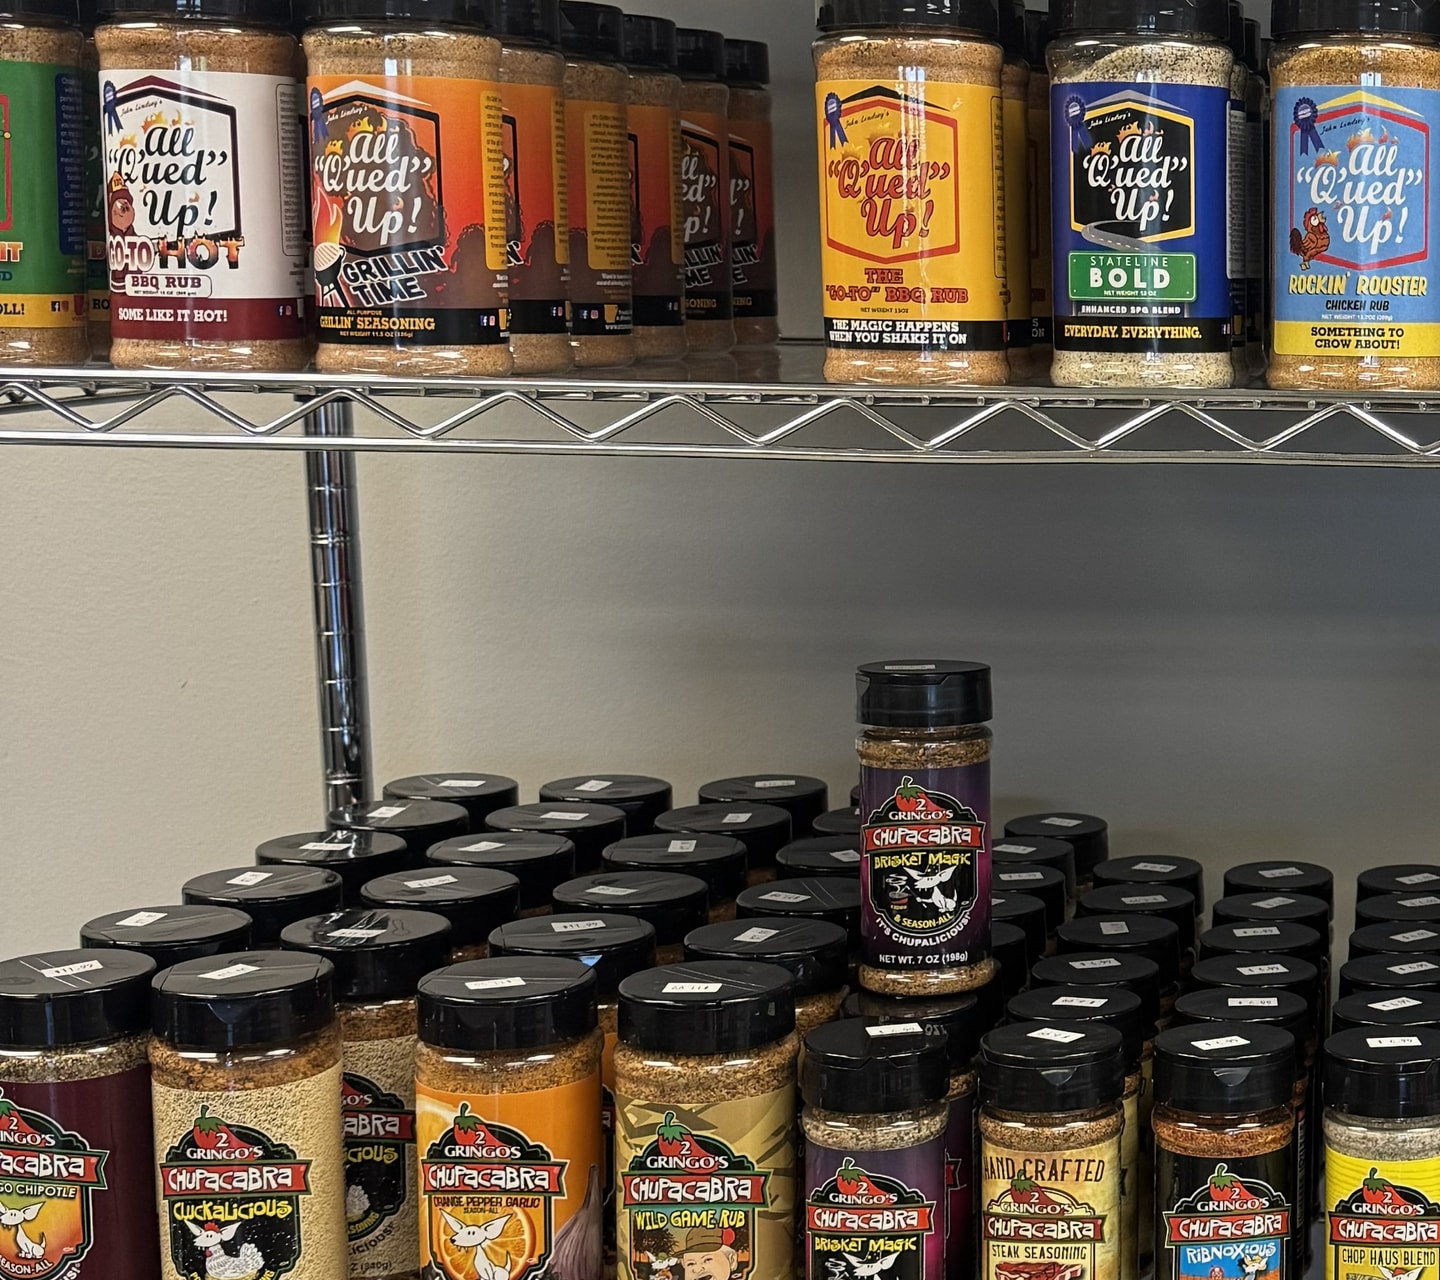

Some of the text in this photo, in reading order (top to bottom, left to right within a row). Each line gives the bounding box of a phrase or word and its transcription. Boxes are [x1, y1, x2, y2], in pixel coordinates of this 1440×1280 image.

[142, 189, 218, 238] Up!
[157, 236, 245, 269] HOT
[343, 246, 448, 285] GRILLIN'
[1090, 255, 1169, 267] STATELINE
[1089, 267, 1171, 289] BOLD
[1288, 272, 1428, 297] ROCKIN' ROOSTER
[350, 276, 427, 307] TIME
[1325, 299, 1390, 312] CHICKEN RUB
[118, 308, 228, 323] SOME LIKE IT HOT!
[356, 317, 436, 331] SEASONING
[832, 319, 960, 333] THE MAGIC HAPPENS
[1064, 324, 1202, 340] EVERYDAY. EVERYTHING.
[1311, 326, 1405, 338] SOMETHING TO
[829, 331, 968, 346] WHEN YOU SHAKE IT ON
[1314, 338, 1400, 350] CROW ABOUT!
[185, 1145, 264, 1161] GRINGO'S
[1022, 1158, 1106, 1183] CRAFTED
[16, 1183, 77, 1199] CHIPOTLE
[433, 1196, 541, 1210] ORANGE PEPPER GARLIC
[634, 1209, 746, 1231] WILD GAME RUB
[992, 1245, 1088, 1261] STEAK SEASONING
[1342, 1248, 1437, 1267] CHOP HAUS BLEND
